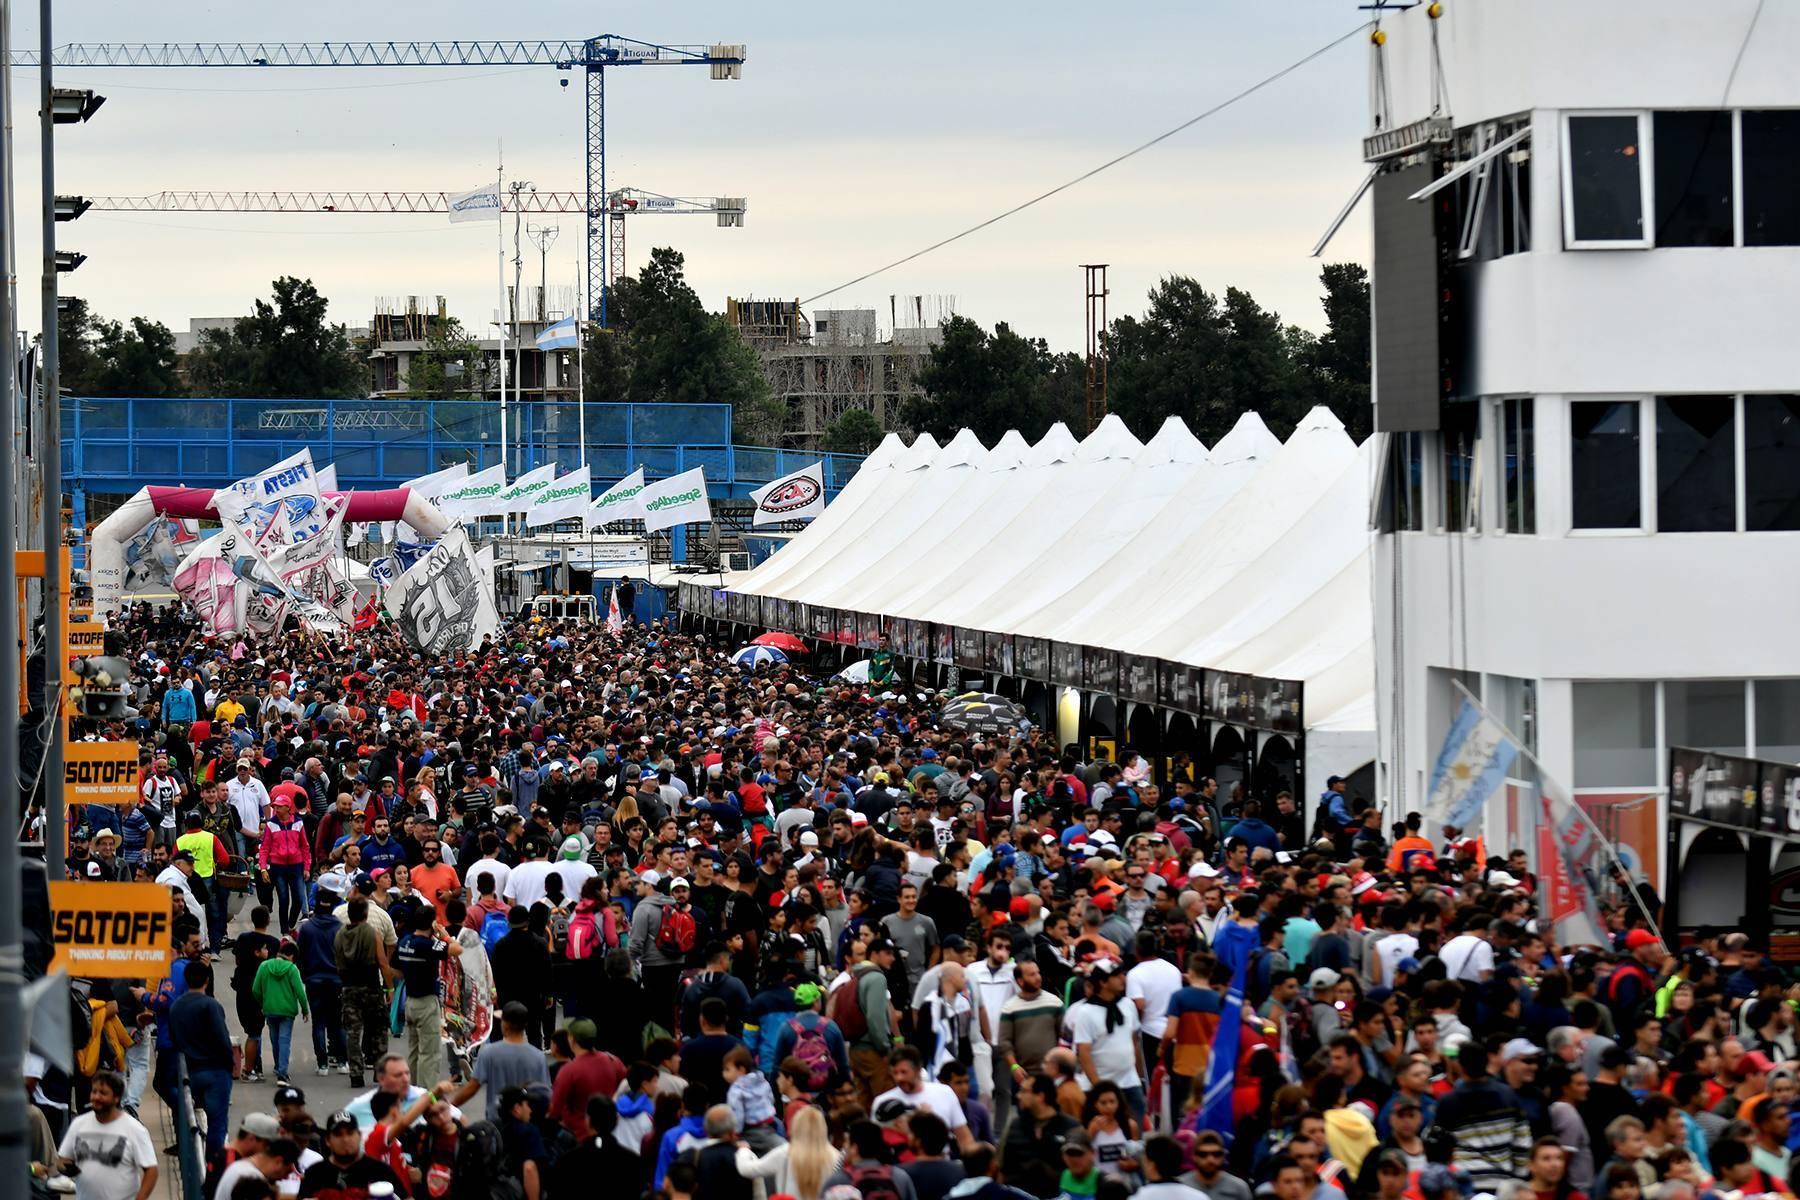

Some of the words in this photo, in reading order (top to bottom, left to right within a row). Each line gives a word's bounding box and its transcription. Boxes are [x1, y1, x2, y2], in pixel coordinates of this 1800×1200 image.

[629, 50, 657, 58] TIGUAN
[64, 761, 138, 783] SQTOFF
[52, 910, 167, 945] SQTOFF
[69, 948, 105, 960] THINKING
[106, 949, 133, 960] ABOUT
[134, 949, 165, 961] FUTURE
